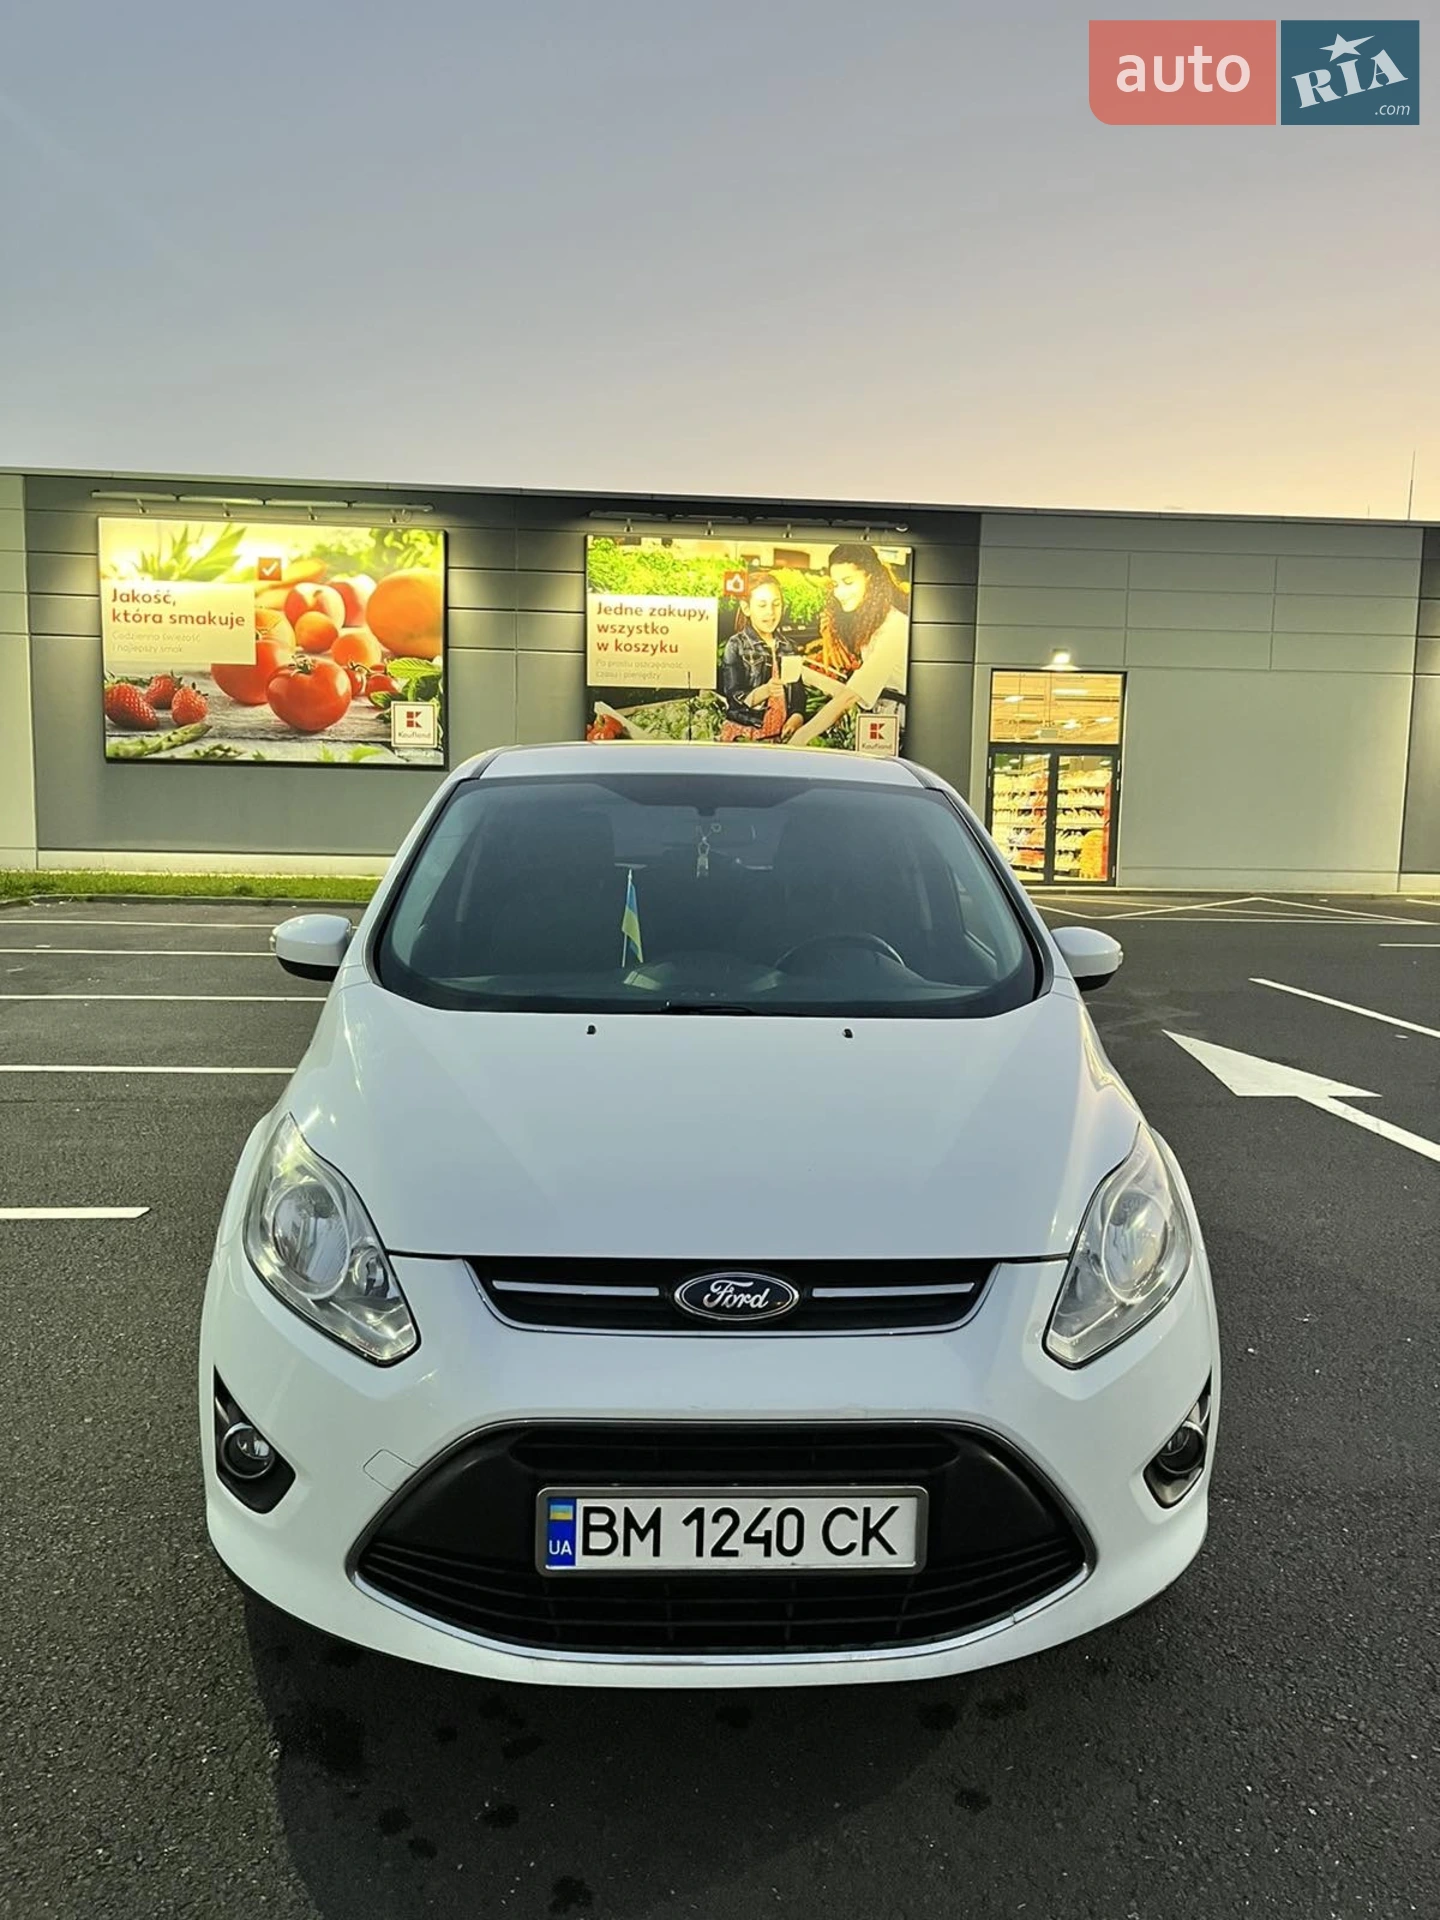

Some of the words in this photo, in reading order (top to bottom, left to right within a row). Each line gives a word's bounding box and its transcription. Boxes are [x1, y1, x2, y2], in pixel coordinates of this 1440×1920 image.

[111, 588, 176, 606] Jakość,
[111, 608, 163, 624] która
[169, 611, 246, 630] smakuje
[596, 601, 644, 617] Jedne
[649, 604, 709, 622] zakupy,
[596, 621, 670, 638] wszystko
[596, 641, 610, 652] w
[614, 638, 679, 657] koszyku
[703, 1279, 771, 1309] Ford
[581, 1506, 661, 1558] BM
[681, 1506, 805, 1558] 1240
[821, 1505, 900, 1557] CK
[549, 1540, 572, 1556] UA
